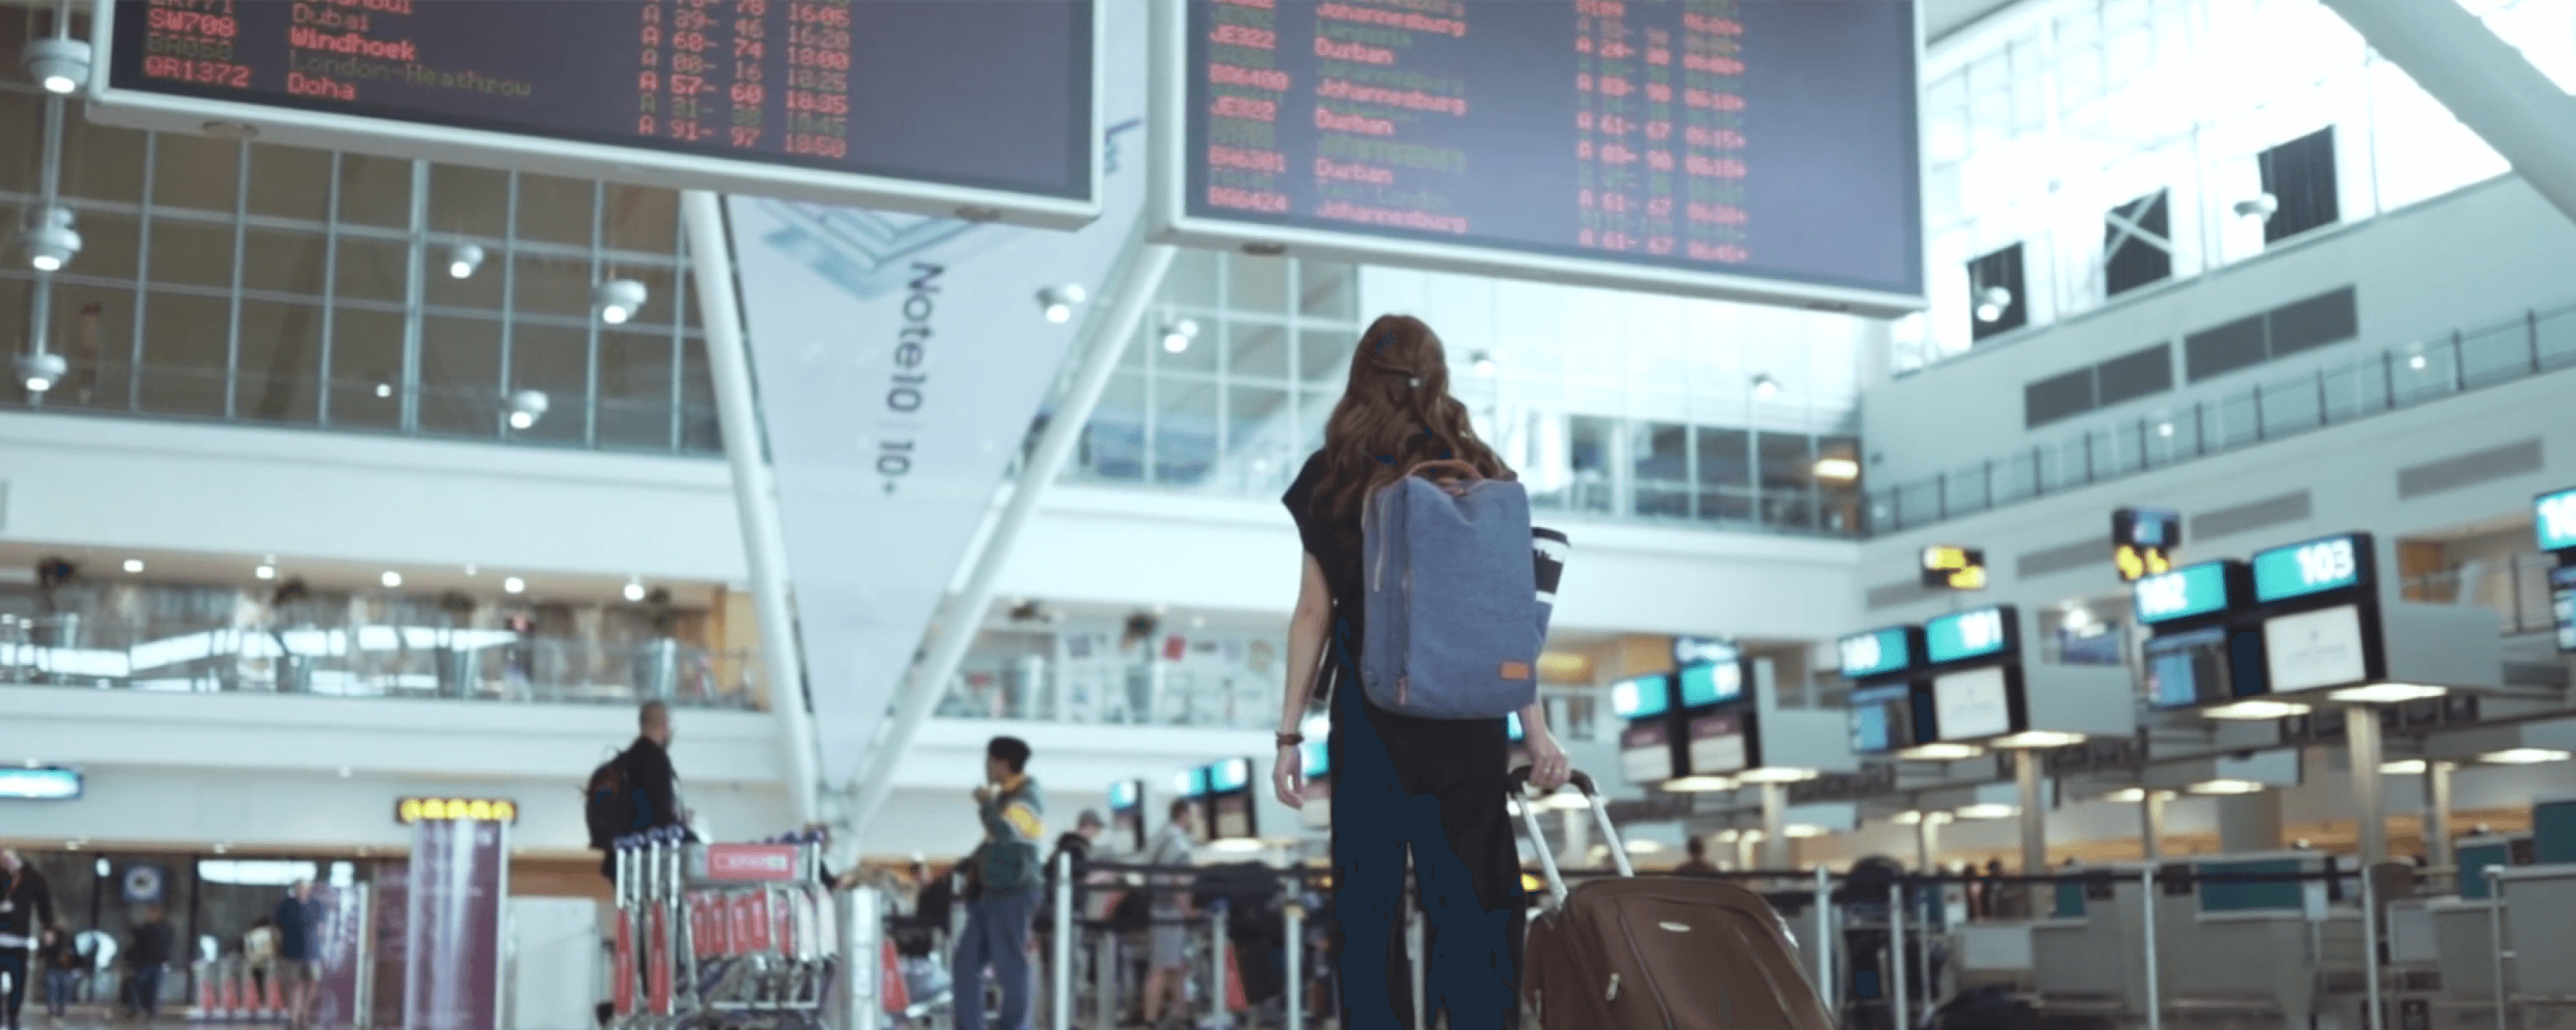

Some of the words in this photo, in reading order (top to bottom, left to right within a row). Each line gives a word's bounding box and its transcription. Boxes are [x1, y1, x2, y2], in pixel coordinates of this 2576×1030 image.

[292, 3, 369, 32] Dubai
[289, 25, 417, 61] Windhoek
[640, 70, 657, 92] A
[1314, 35, 1395, 64] Durban
[144, 55, 251, 88] QR1372
[287, 71, 356, 100] Doha
[638, 115, 655, 136] A
[1315, 76, 1467, 117] Johannesburg
[1314, 106, 1396, 136] Durban
[1314, 156, 1394, 185] Durban
[886, 261, 945, 413] Note10
[876, 439, 915, 494] 10+
[2296, 539, 2354, 585] 103
